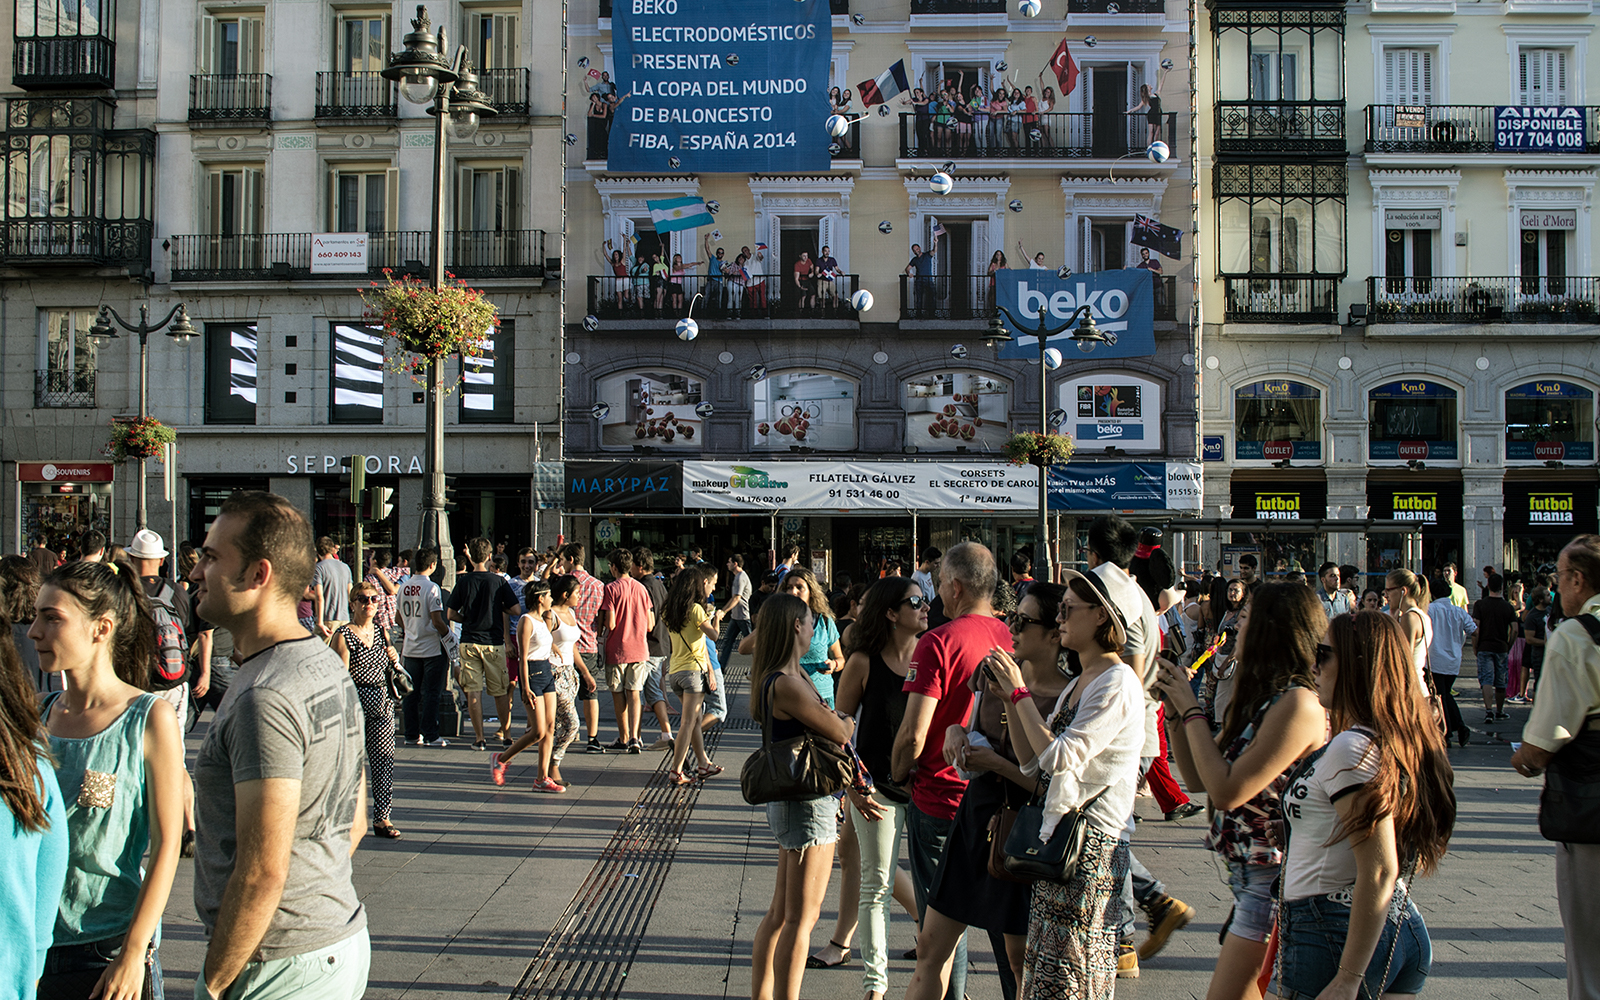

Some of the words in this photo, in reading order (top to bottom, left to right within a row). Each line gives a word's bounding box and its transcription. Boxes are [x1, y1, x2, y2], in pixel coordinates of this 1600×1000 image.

[632, 0, 678, 15] BEKO
[631, 23, 816, 42] ELECTRODOMÉSTICOS
[631, 54, 721, 70] PRESENTA
[632, 81, 654, 96] LA
[657, 81, 703, 97] COPA
[707, 80, 739, 96] DEL
[743, 78, 807, 96] MUNDO
[631, 107, 654, 123] DE
[658, 106, 773, 124] BALONCESTO
[1498, 107, 1582, 118] AIMA
[1497, 119, 1582, 130] DISPONIBLE
[629, 133, 675, 151] FIBA,
[679, 131, 749, 150] ESPAÑA
[753, 132, 797, 148] 2014
[1498, 131, 1524, 147] 917
[1527, 131, 1553, 147] 704
[1557, 131, 1582, 147] 008
[1394, 212, 1419, 220] solución
[1426, 212, 1440, 220] acné
[1521, 214, 1540, 227] Geli
[1017, 281, 1129, 319] beko
[1096, 424, 1123, 434] beko
[1536, 447, 1562, 455] OUTLET
[286, 455, 424, 474] SEPORA
[809, 473, 868, 483] FILATELIA
[871, 471, 916, 484] GÁLVEZ
[960, 470, 1005, 478] CORSETS
[1094, 474, 1117, 486] MÁS
[571, 476, 670, 493] MARYPAZ
[692, 480, 728, 489] makeup
[929, 480, 941, 488] EL
[943, 480, 989, 488] SECRETO
[991, 480, 1004, 488] DE
[1007, 480, 1040, 488] CAROL
[829, 489, 841, 499] 91
[846, 489, 866, 499] 531
[869, 489, 883, 499] 46
[886, 489, 900, 499] 00
[974, 496, 1012, 504] PLANTA
[1256, 496, 1300, 510] futbol
[1393, 495, 1437, 510] futbol
[1529, 496, 1573, 510] futbol
[1256, 511, 1300, 519] mania
[1393, 511, 1437, 521] mania
[1529, 511, 1573, 522] mania
[403, 585, 421, 597] GBR
